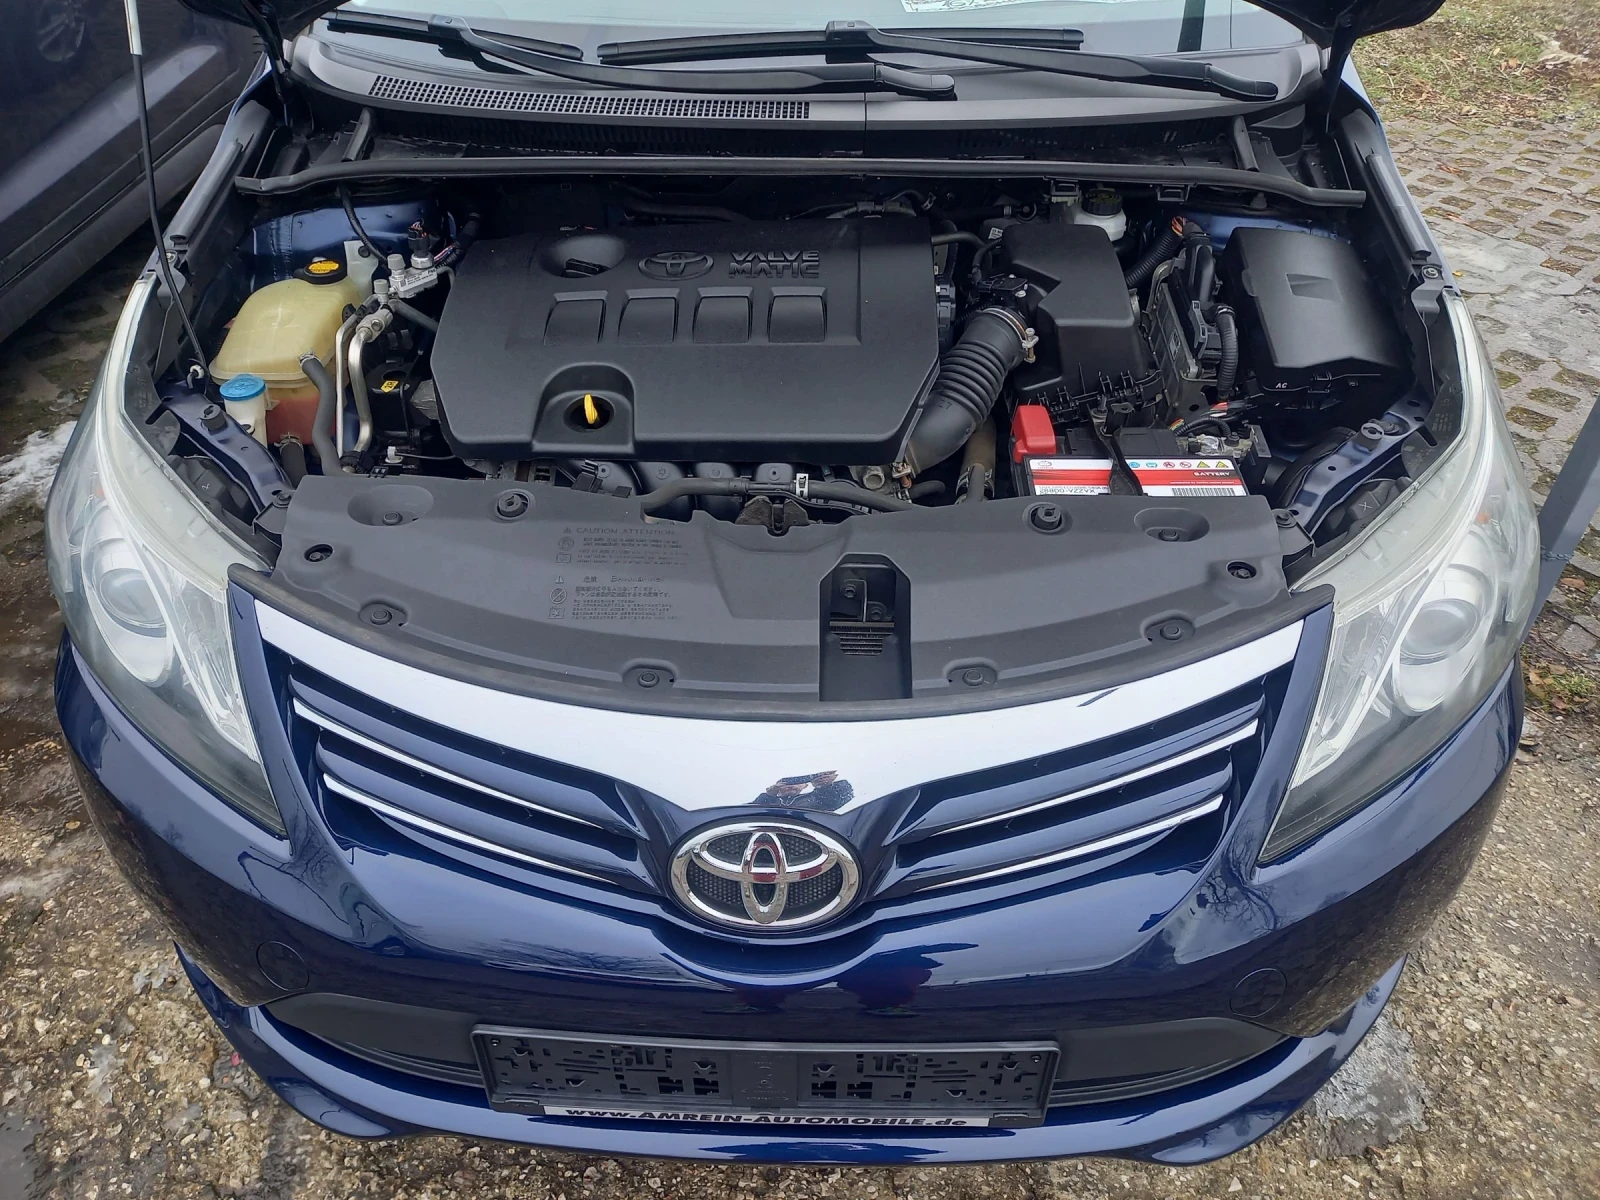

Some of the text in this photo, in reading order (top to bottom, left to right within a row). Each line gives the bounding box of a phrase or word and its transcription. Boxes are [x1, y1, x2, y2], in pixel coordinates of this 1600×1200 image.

[731, 251, 820, 261] VALVE
[729, 262, 820, 278] MATIC
[565, 1108, 968, 1127] www.AMREIN-AUTOMOBILE.de
